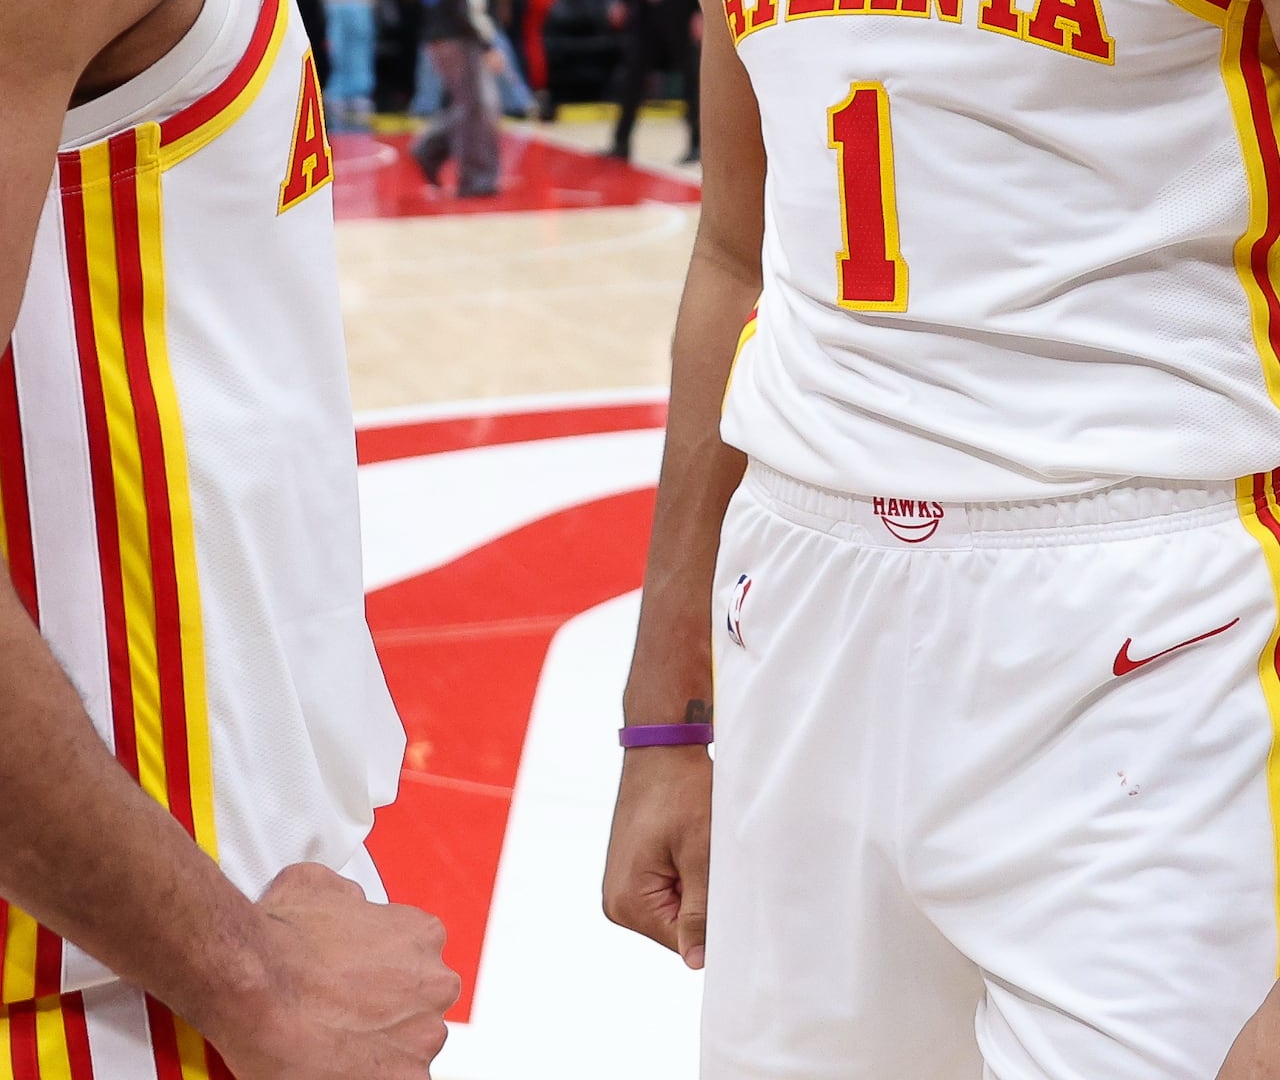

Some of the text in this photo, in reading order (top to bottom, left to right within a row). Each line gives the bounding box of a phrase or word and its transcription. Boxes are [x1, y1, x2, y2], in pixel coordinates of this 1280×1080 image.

[276, 46, 335, 217] A
[826, 80, 910, 313] 1
[873, 496, 944, 519] HAWKS
